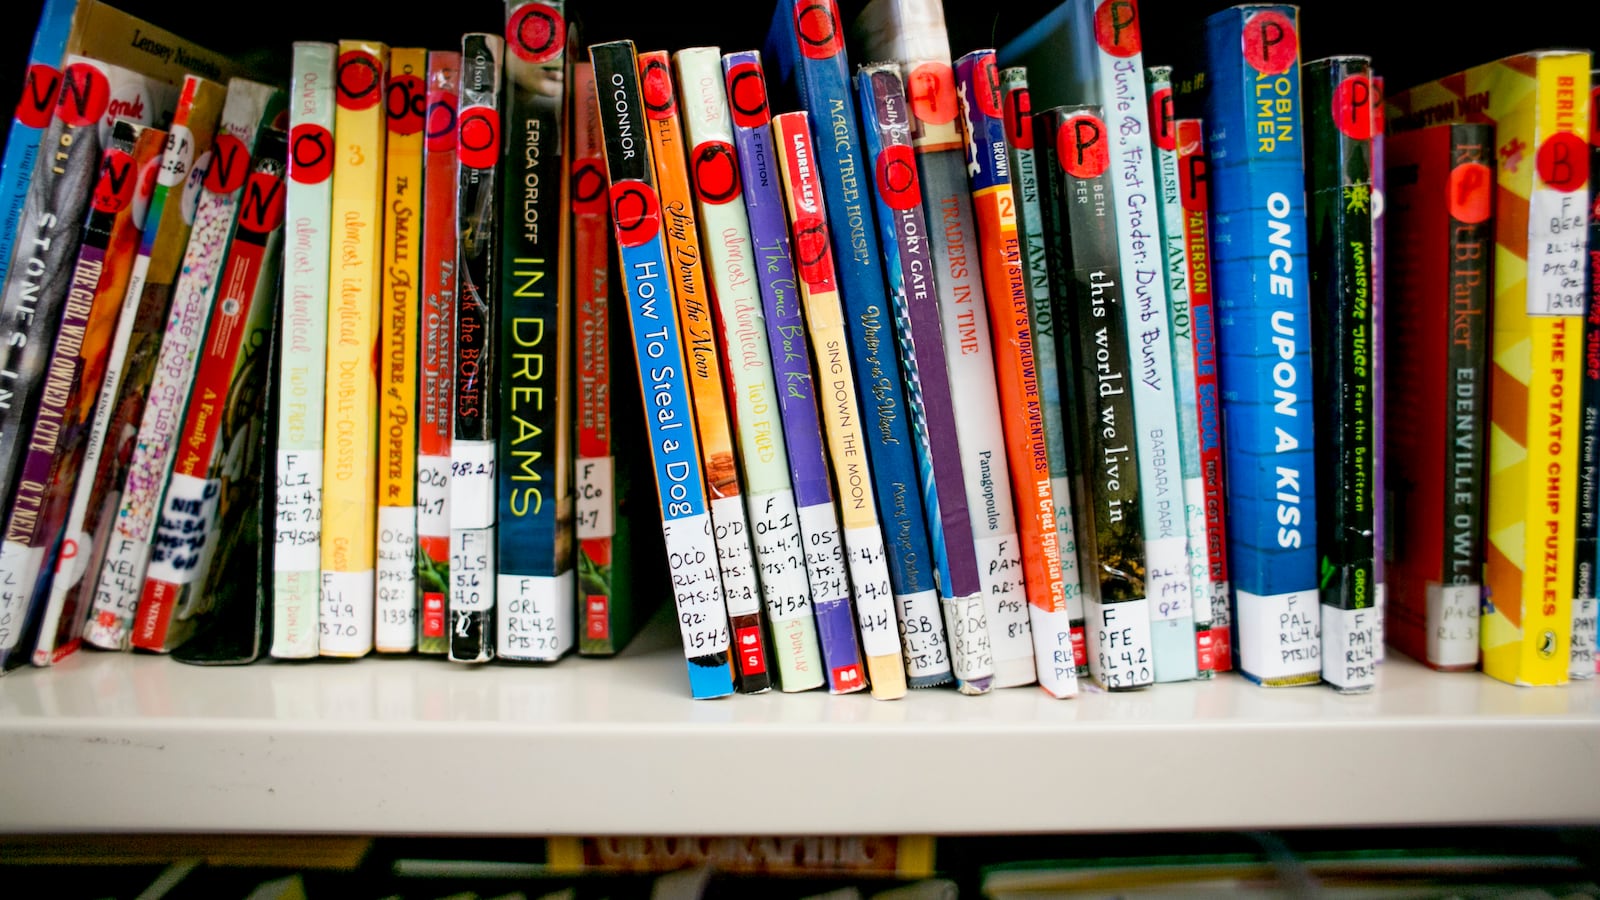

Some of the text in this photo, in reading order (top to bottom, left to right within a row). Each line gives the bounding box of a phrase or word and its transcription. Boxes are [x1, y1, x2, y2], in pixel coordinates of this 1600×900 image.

[517, 12, 556, 53] O
[799, 4, 837, 46] O
[1111, 2, 1135, 46] P
[1261, 21, 1283, 62] P
[59, 66, 92, 117] N
[337, 57, 378, 99] O
[474, 54, 486, 90] Olson
[641, 61, 674, 111] O
[731, 70, 767, 115] O
[611, 73, 635, 160] O'CONNOR
[698, 75, 716, 122] OLIVER
[1352, 81, 1369, 124] P
[461, 115, 494, 150] O
[1075, 120, 1100, 165] P
[202, 140, 238, 188] N
[696, 145, 738, 199] O
[753, 144, 768, 188] FICTION
[792, 132, 817, 215] LAUREL-LEAF
[829, 98, 867, 262] MAGIC TREE HOUSE
[886, 159, 914, 193] O
[992, 140, 1009, 177] BROWN
[242, 181, 281, 226] N
[524, 119, 540, 244] ERICA ORLOFF
[1093, 184, 1105, 217] BETH
[615, 189, 648, 231] O
[1000, 196, 1015, 217] 2
[1113, 60, 1161, 392] Junie First Grader: Dumb Bunny
[10, 212, 57, 348] STONES
[664, 200, 714, 379] Sing Down the Moon
[941, 193, 979, 356] TRADERS IN TIME
[1027, 233, 1053, 337] LAWN BOY
[1167, 233, 1191, 340] LAWN BOY
[721, 228, 764, 371] almost identical
[759, 239, 811, 400] The Comic Book Kid
[1453, 269, 1482, 350] Parker
[335, 210, 362, 481] almost identical DOUBLE-CROSSED
[387, 176, 410, 479] The ADVENTURE of POPEYE
[438, 260, 454, 436] The FANTASTIC SECRET
[460, 280, 480, 418] Ask the BONES
[30, 259, 103, 454] THE GIRL WHO OWNED A CITY
[152, 292, 200, 444] cake pop crush
[1193, 304, 1218, 453] MIDDLE SCHOOL
[1266, 191, 1302, 550] ONCE UPON A KISS
[425, 370, 438, 424] JESTER
[509, 258, 545, 518] IN DREAMS
[1089, 269, 1134, 524] this world we live in
[87, 427, 100, 460] EQUAL
[652, 366, 693, 516] Steal a Dog
[826, 340, 865, 510] SING DOWN THE MOON
[1005, 238, 1067, 613] FLAT STANLEY'S WORLDWIDE ADVENTURES: The Great Egyptian Grave
[287, 455, 298, 471] F
[583, 463, 594, 479] F
[1150, 429, 1175, 539] BARBARA PARK
[1452, 367, 1475, 588] EDENVILLE OWLS
[1543, 319, 1565, 616] THE POTATO CHIP PUZZLES
[1580, 407, 1597, 528] Zits from Python Pit
[417, 497, 444, 515] 4.7
[764, 498, 776, 514] F
[979, 450, 1000, 531] Panagopoulos
[462, 533, 474, 551] F
[756, 514, 793, 535] OLI
[107, 559, 136, 578] NEL
[119, 540, 134, 554] F
[989, 558, 1022, 575] PAN
[997, 541, 1009, 556] F
[323, 573, 333, 587] F
[455, 590, 480, 605] 4.0
[456, 574, 479, 587] 5.6
[520, 579, 531, 596] F
[1355, 568, 1366, 609] GROSS
[330, 604, 354, 618] 4.9
[508, 599, 541, 614] ORL
[904, 600, 913, 616] F
[1102, 609, 1116, 627] F
[1280, 613, 1312, 629] PAL
[1287, 595, 1297, 611] F
[1355, 613, 1364, 628] F
[1121, 648, 1148, 666] 4.2
[1349, 627, 1373, 646] PAY
[748, 656, 758, 667] S
[1126, 666, 1150, 685] 9.0
